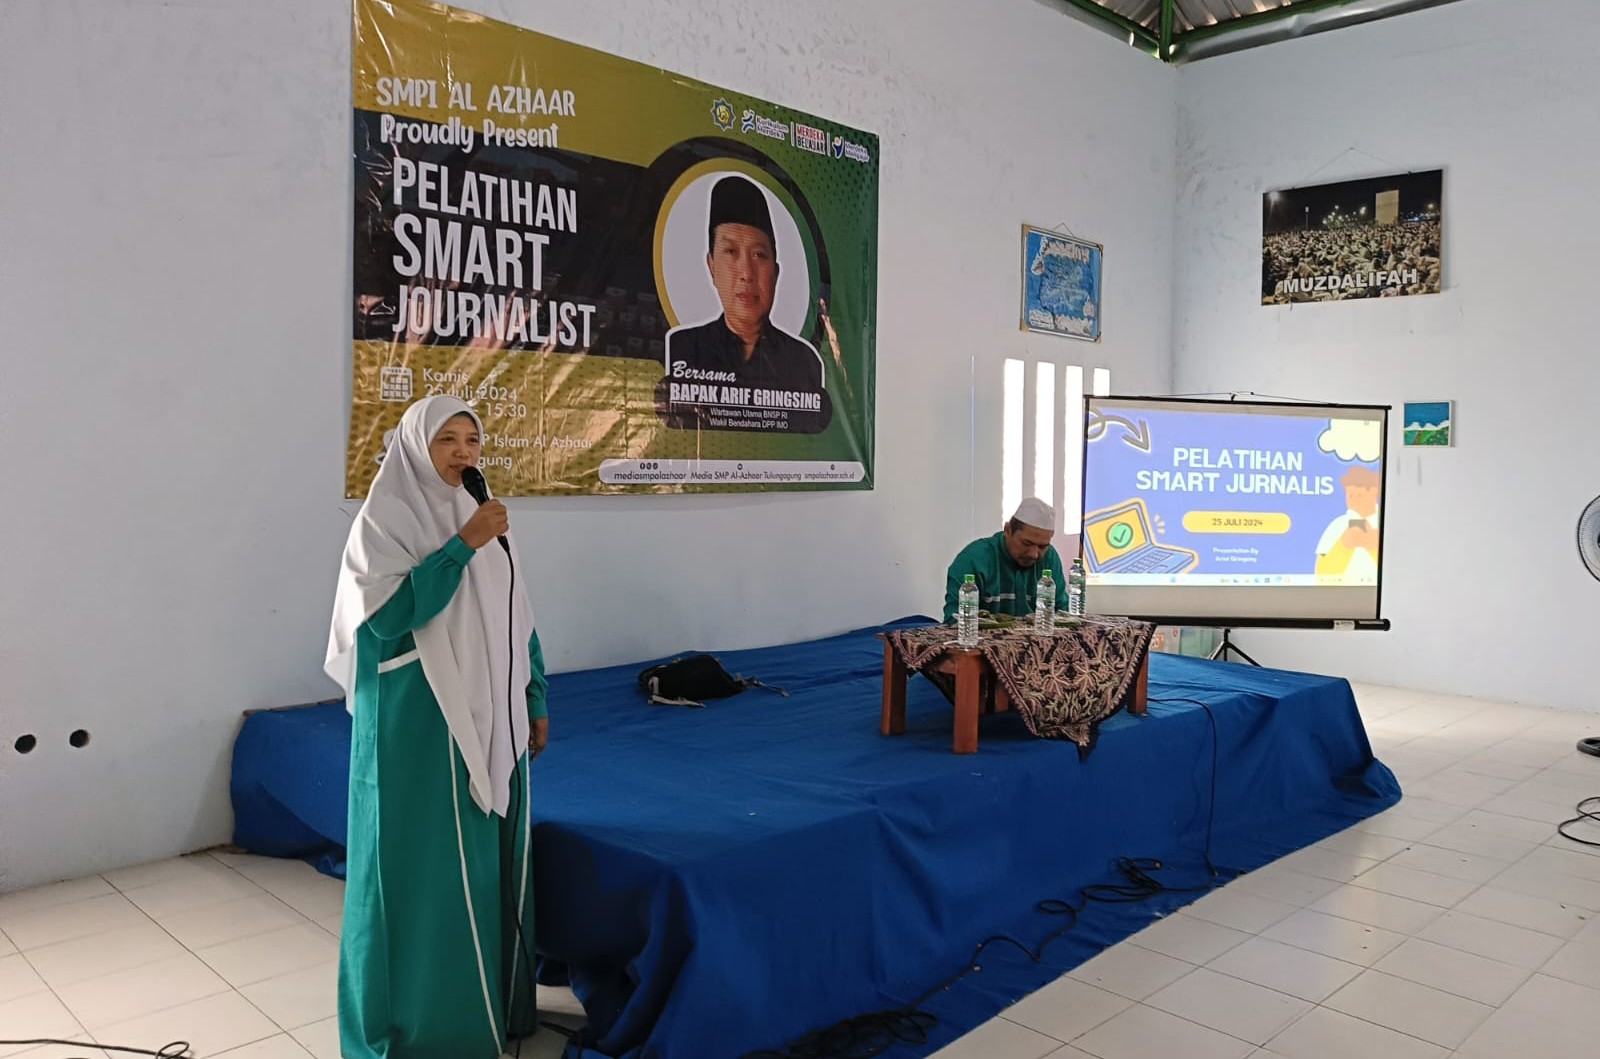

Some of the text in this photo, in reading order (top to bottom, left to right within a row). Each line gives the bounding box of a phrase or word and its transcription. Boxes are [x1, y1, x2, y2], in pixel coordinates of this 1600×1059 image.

[376, 76, 576, 117] SMPI AL AZHAAR
[380, 113, 559, 153] Proudly Present
[796, 123, 825, 141] MERDEKA
[797, 137, 826, 154] BELAJAR
[392, 156, 578, 234] PELATIHAN
[392, 212, 550, 292] SMART
[1283, 268, 1418, 294] MUZDALIFAH
[391, 284, 596, 348] JOURNALIST
[423, 367, 471, 384] Kamis
[672, 360, 737, 383] Bersama
[479, 386, 518, 402] 2024
[669, 382, 821, 409] BAPAK ARIF GRINGSING
[486, 402, 527, 417] 15.30
[710, 408, 788, 419] Wartawan Utama BNSP RI
[710, 417, 727, 427] Wakil
[728, 418, 761, 428] Bendahara
[761, 420, 775, 429] DPP
[494, 433, 529, 448] Islam
[533, 434, 547, 448] Al
[1173, 446, 1303, 472] PELATIHAN
[691, 470, 713, 480] Media
[714, 471, 730, 480] SMP
[731, 470, 762, 480] Al-Azhaar
[1135, 469, 1335, 496] SMART JURNALIS
[1212, 518, 1263, 527] 25 JULI 2024
